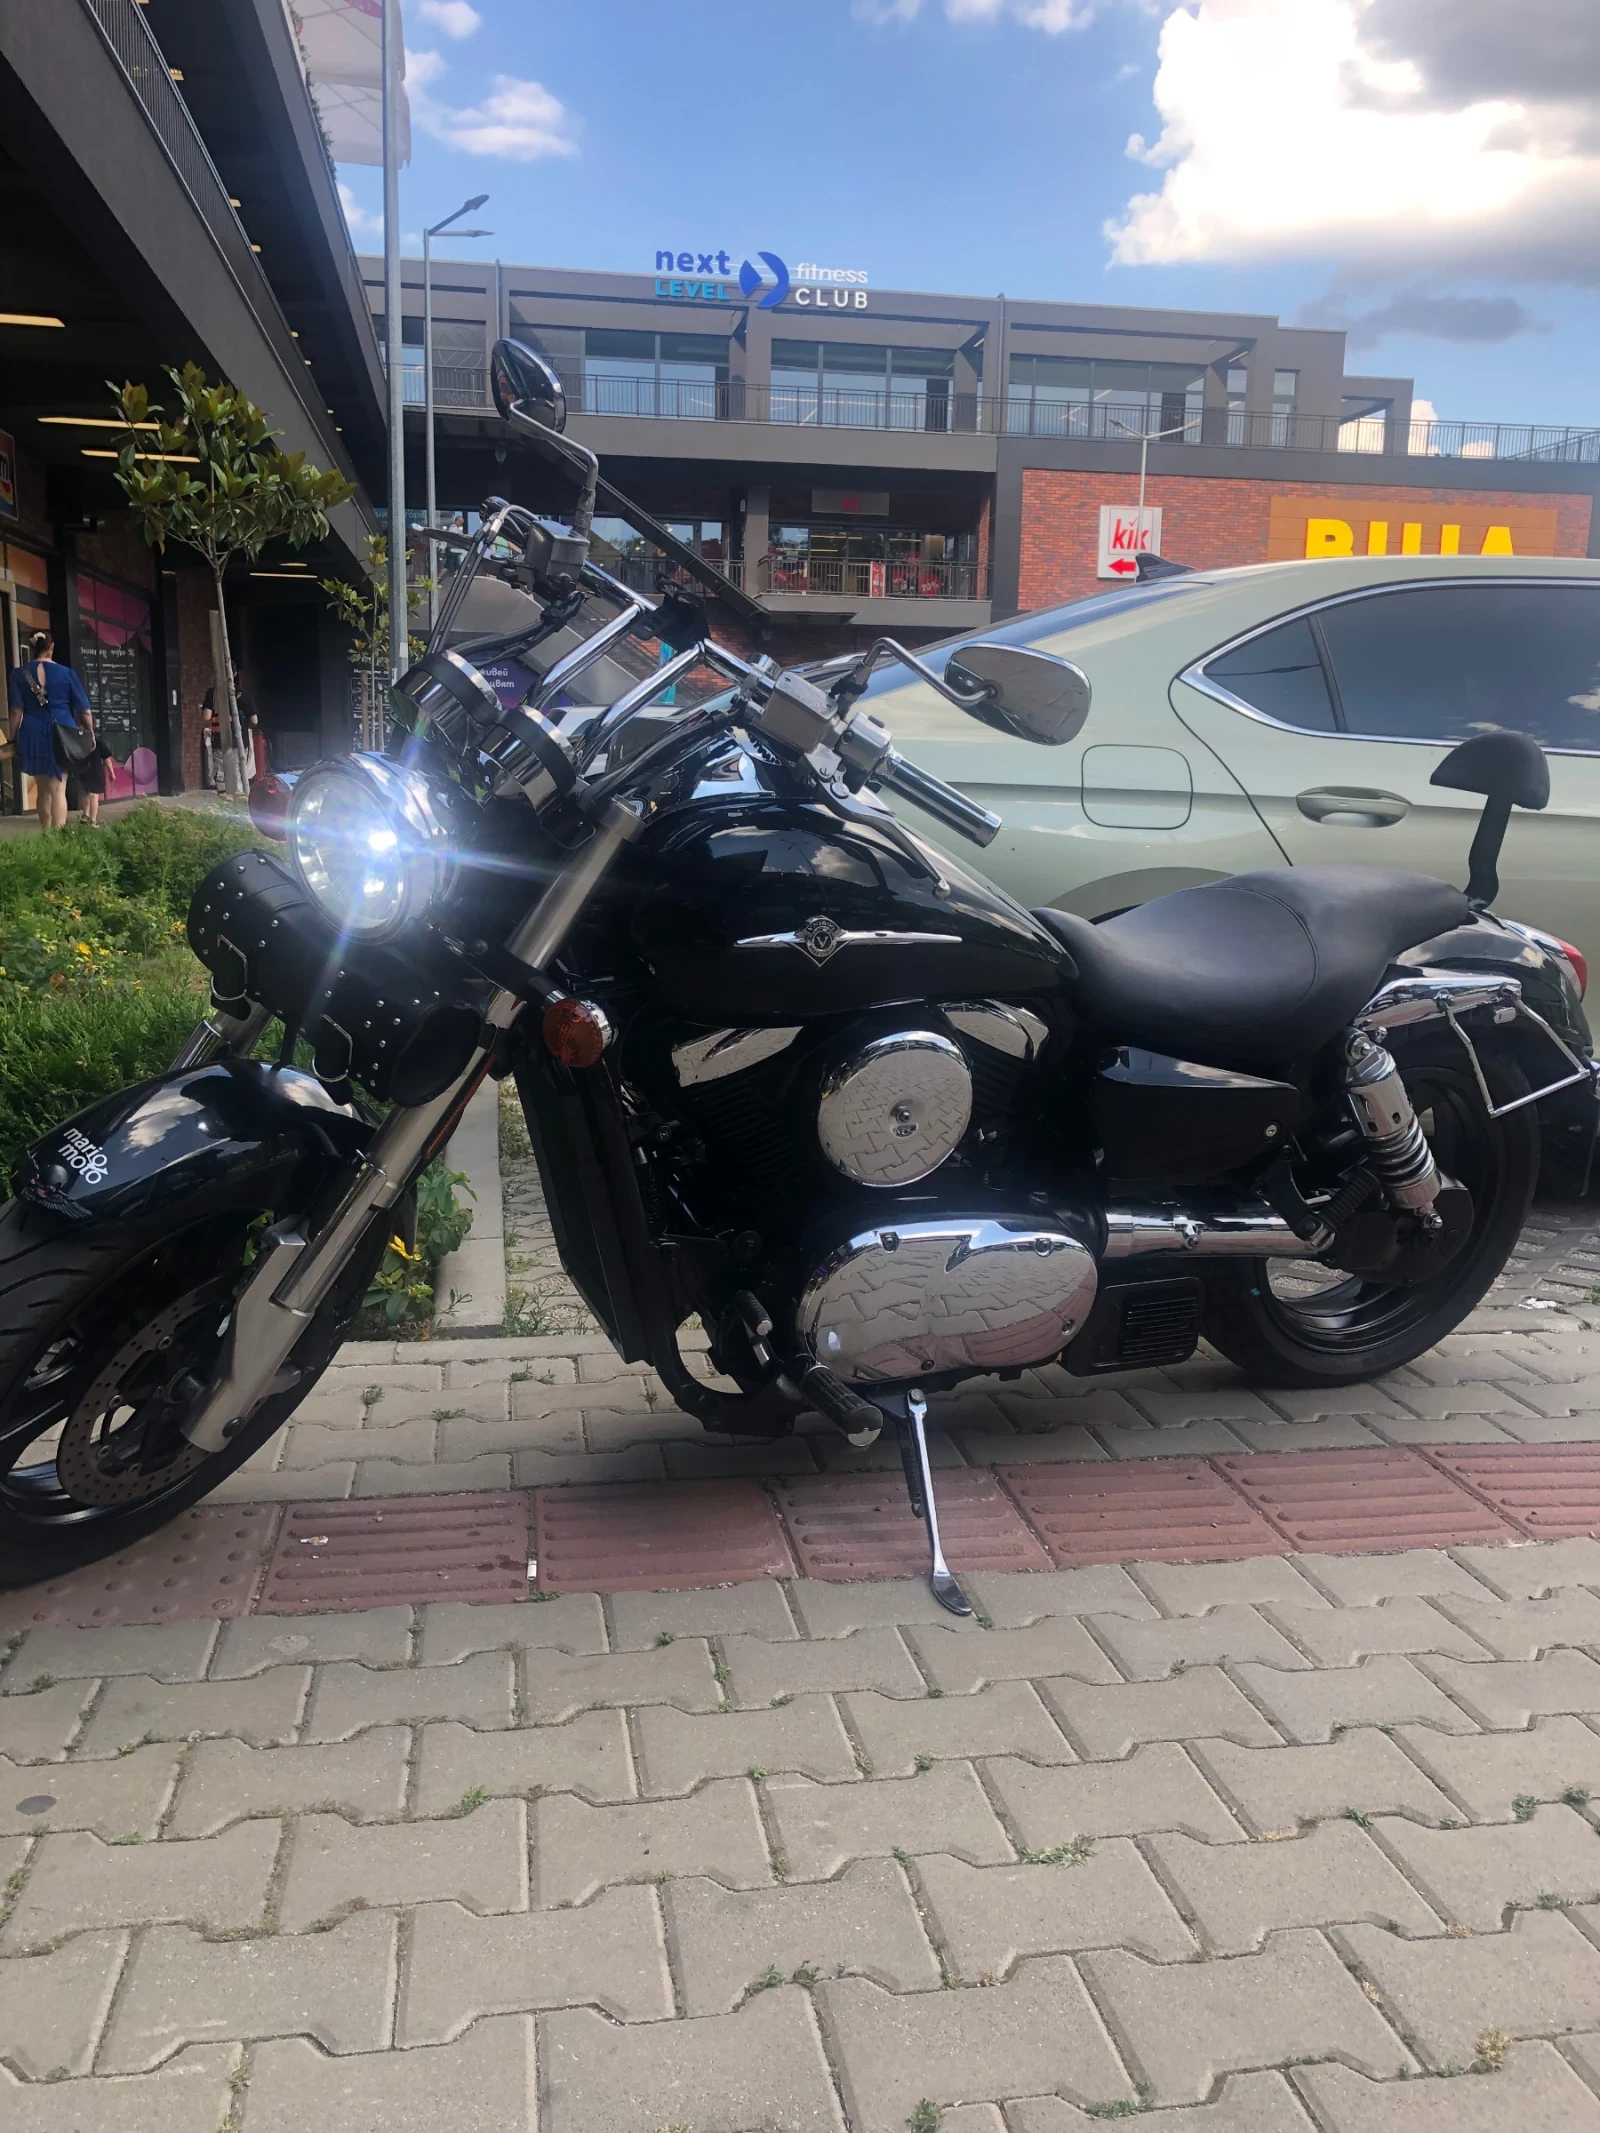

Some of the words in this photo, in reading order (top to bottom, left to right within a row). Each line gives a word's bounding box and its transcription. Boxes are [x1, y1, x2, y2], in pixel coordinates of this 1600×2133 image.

[655, 250, 731, 276] next
[796, 262, 868, 284] fitness
[655, 278, 730, 301] LEVEL
[795, 287, 868, 309] CLUB
[1112, 517, 1149, 550] kik
[921, 581, 939, 592] 70%
[816, 936, 829, 949] V
[63, 1128, 108, 1167] mario
[58, 1143, 102, 1185] moto
